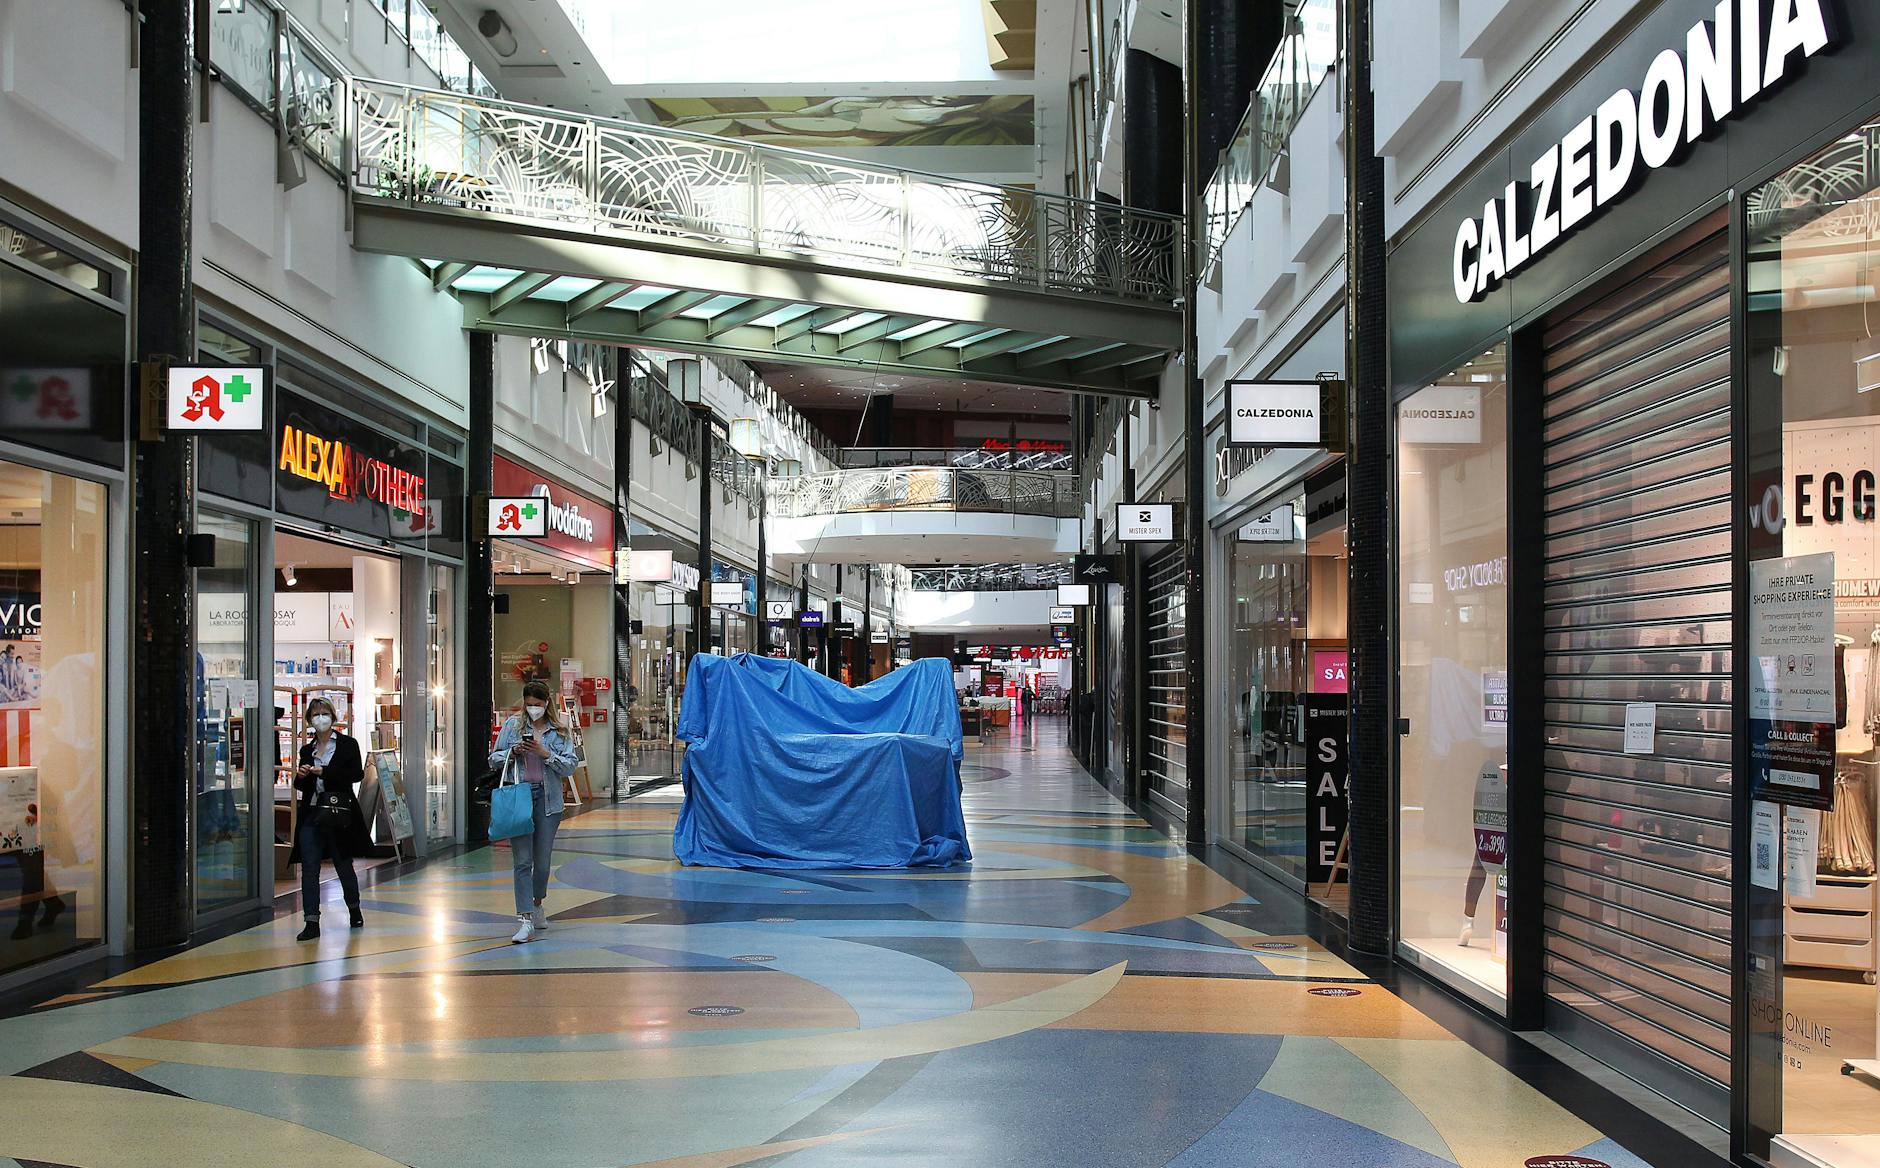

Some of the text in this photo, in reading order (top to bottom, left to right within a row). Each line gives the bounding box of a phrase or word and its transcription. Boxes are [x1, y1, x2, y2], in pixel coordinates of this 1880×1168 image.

[1453, 0, 1829, 304] CALZEDONIA
[1237, 408, 1314, 418] CALZEDONIA
[280, 425, 425, 516] ALEXA APOTHEKE
[1784, 469, 1875, 526] EGG
[551, 502, 593, 543] vodafone
[1129, 527, 1162, 535] MISTER SPEX
[1768, 574, 1814, 588] IHRE PRIVATE
[1834, 580, 1880, 597] HOMEW
[1753, 588, 1832, 605] SHOPPING EXPERIENCE
[1840, 599, 1864, 608] comfort
[209, 610, 296, 620] LA ROC OSAY
[1325, 668, 1346, 680] SA
[1767, 730, 1783, 740] CALL
[1788, 732, 1815, 743] COLLECT
[1316, 737, 1339, 867] SALE
[1479, 834, 1484, 850] 2
[1751, 999, 1832, 1047] SHOP ONLINE
